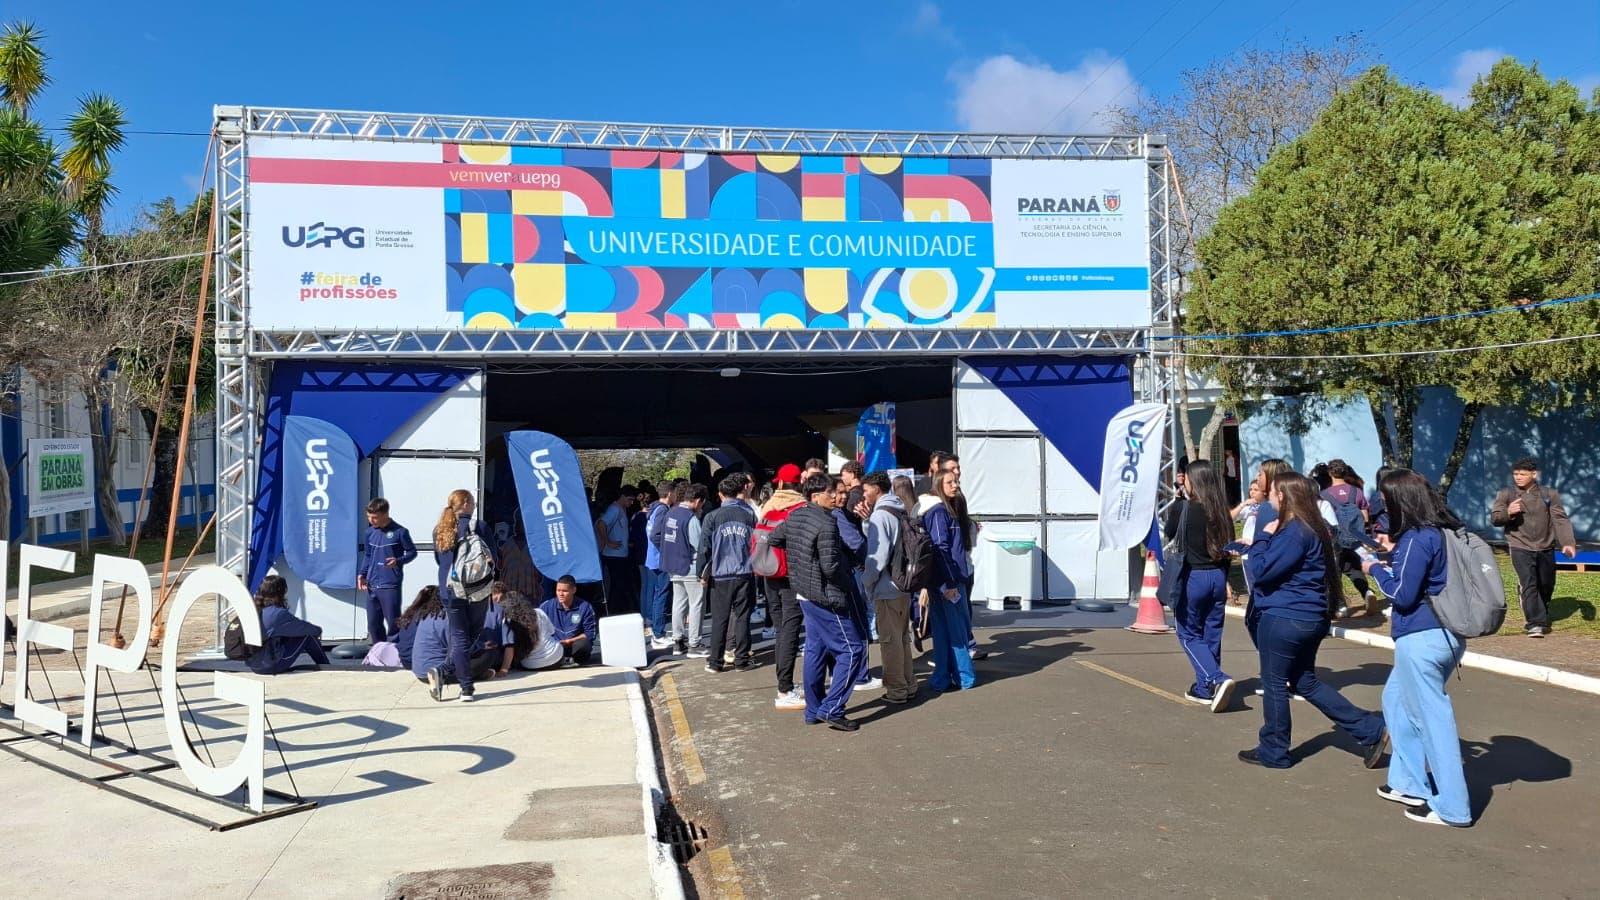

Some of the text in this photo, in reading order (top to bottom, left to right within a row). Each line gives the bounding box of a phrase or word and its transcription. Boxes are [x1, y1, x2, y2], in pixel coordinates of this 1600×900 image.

[1018, 196, 1100, 212] PARANÁ
[282, 221, 364, 248] UEPG
[589, 230, 977, 257] UNIVERSIDADE E COMUNIDADE
[300, 284, 397, 301] profissões
[41, 455, 82, 476] PARANÁ
[1120, 420, 1145, 484] UEPG
[41, 474, 82, 491] EM OBRAS
[305, 439, 334, 510] UEPG
[530, 448, 563, 516] UEPG
[0, 540, 266, 814] EPG
